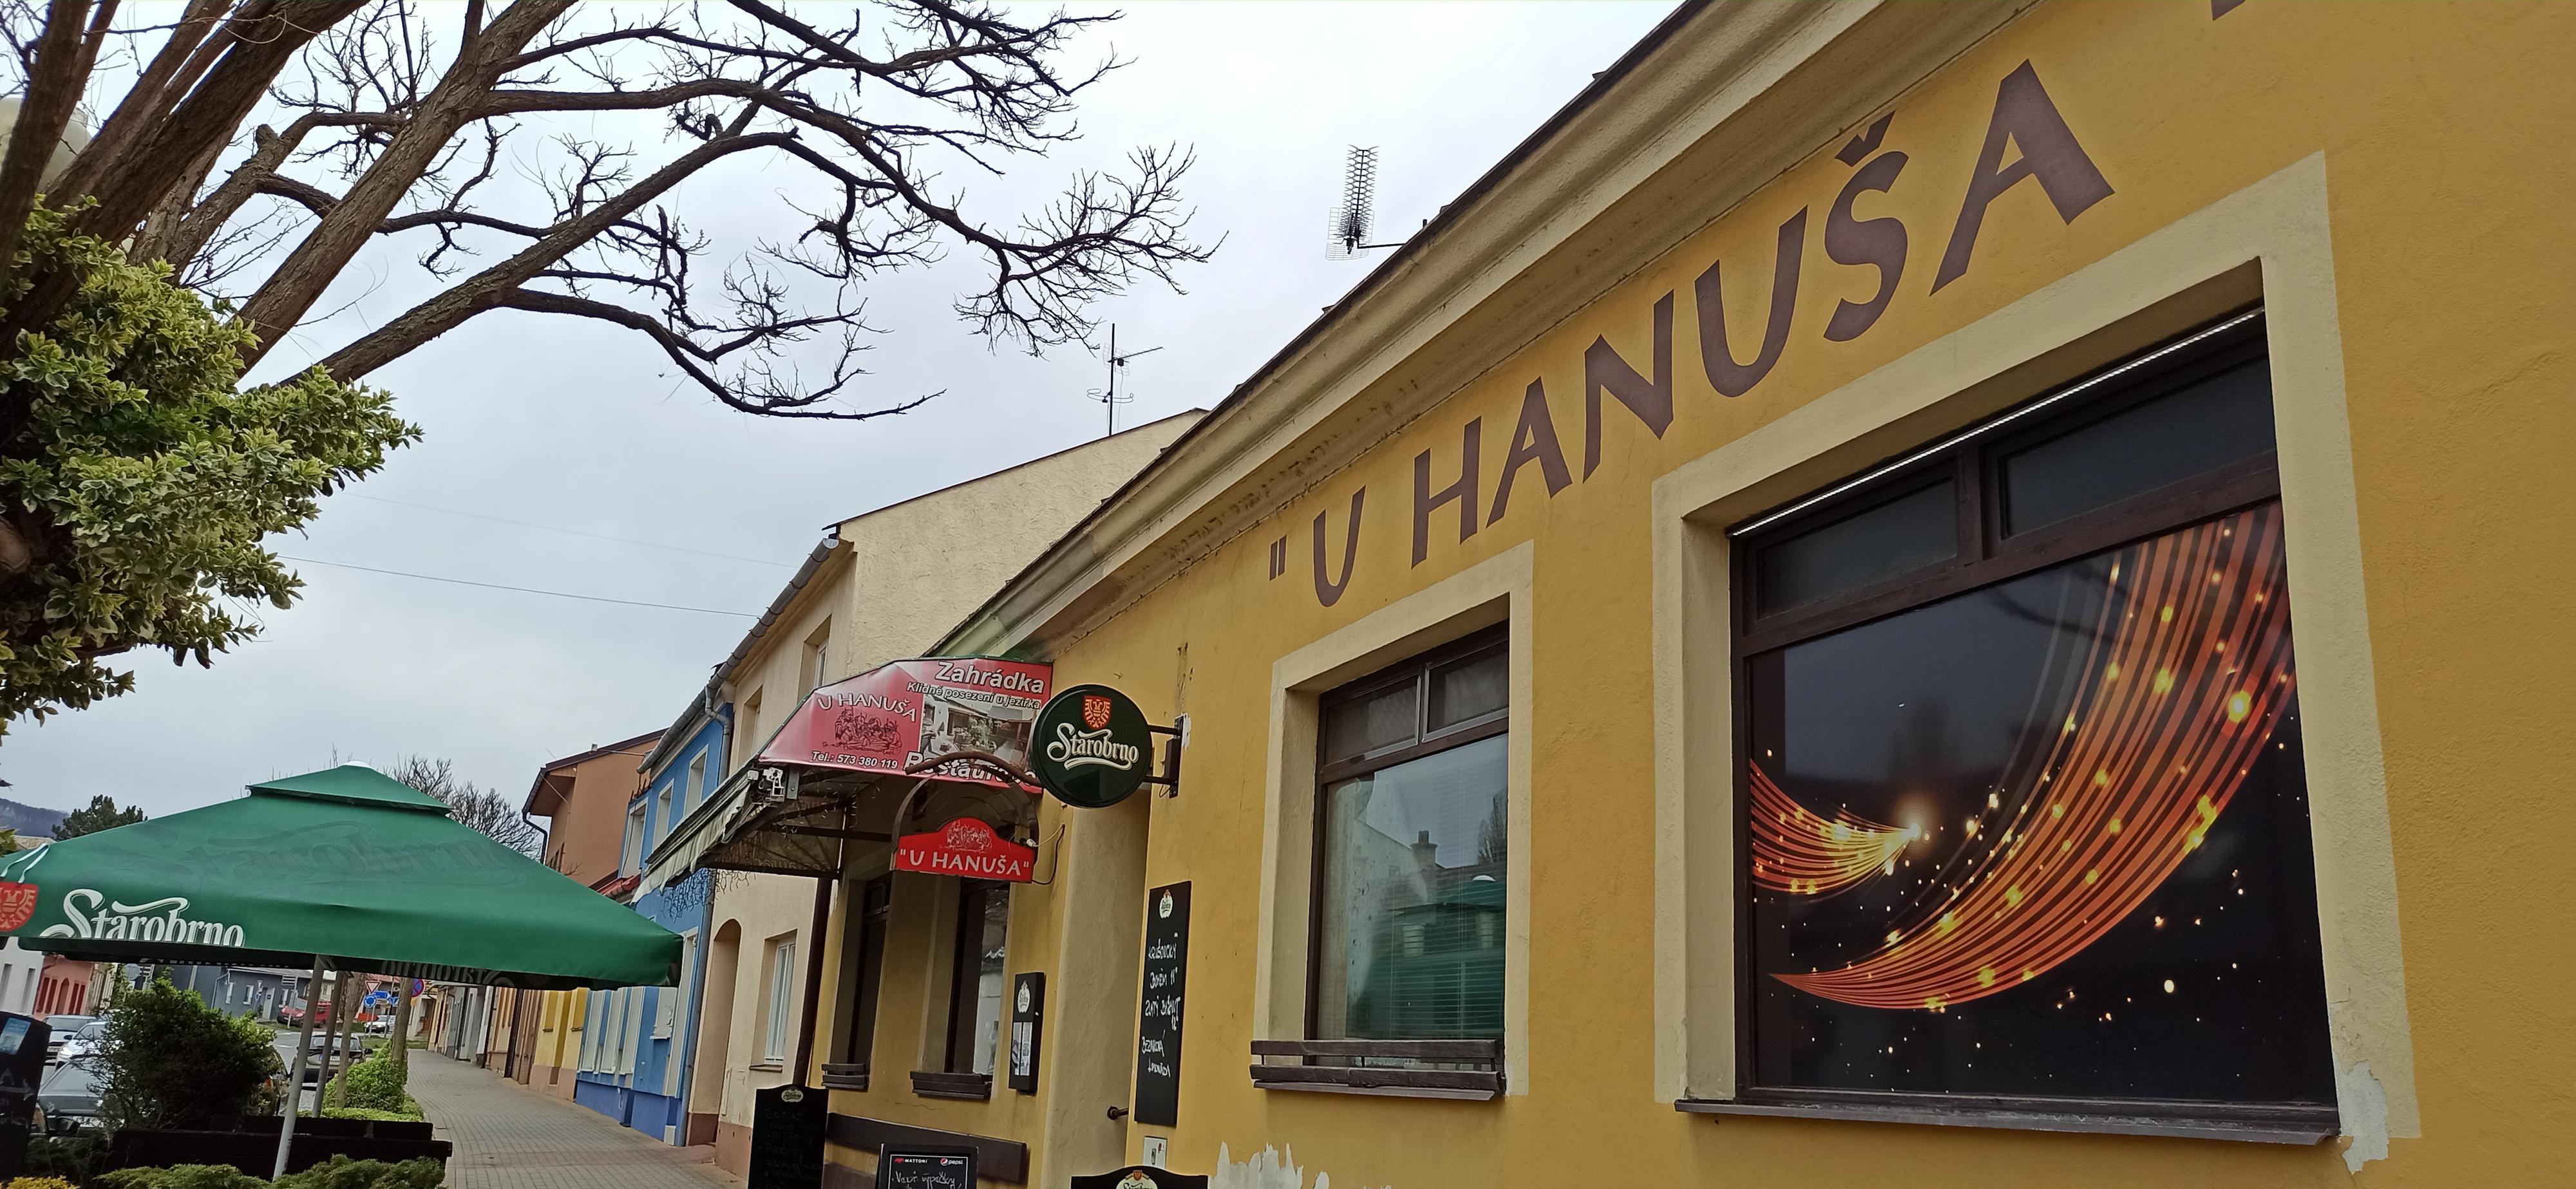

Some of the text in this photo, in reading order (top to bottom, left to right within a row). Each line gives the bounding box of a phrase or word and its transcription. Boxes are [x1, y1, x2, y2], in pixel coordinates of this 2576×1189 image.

[935, 660, 1045, 694] Zahrádka
[817, 693, 916, 722] U HANUŠA
[907, 682, 1041, 709] Klidné posezení u jezírka
[812, 751, 898, 769] Tel.: 573 380 119
[1046, 722, 1139, 771] Starobrno
